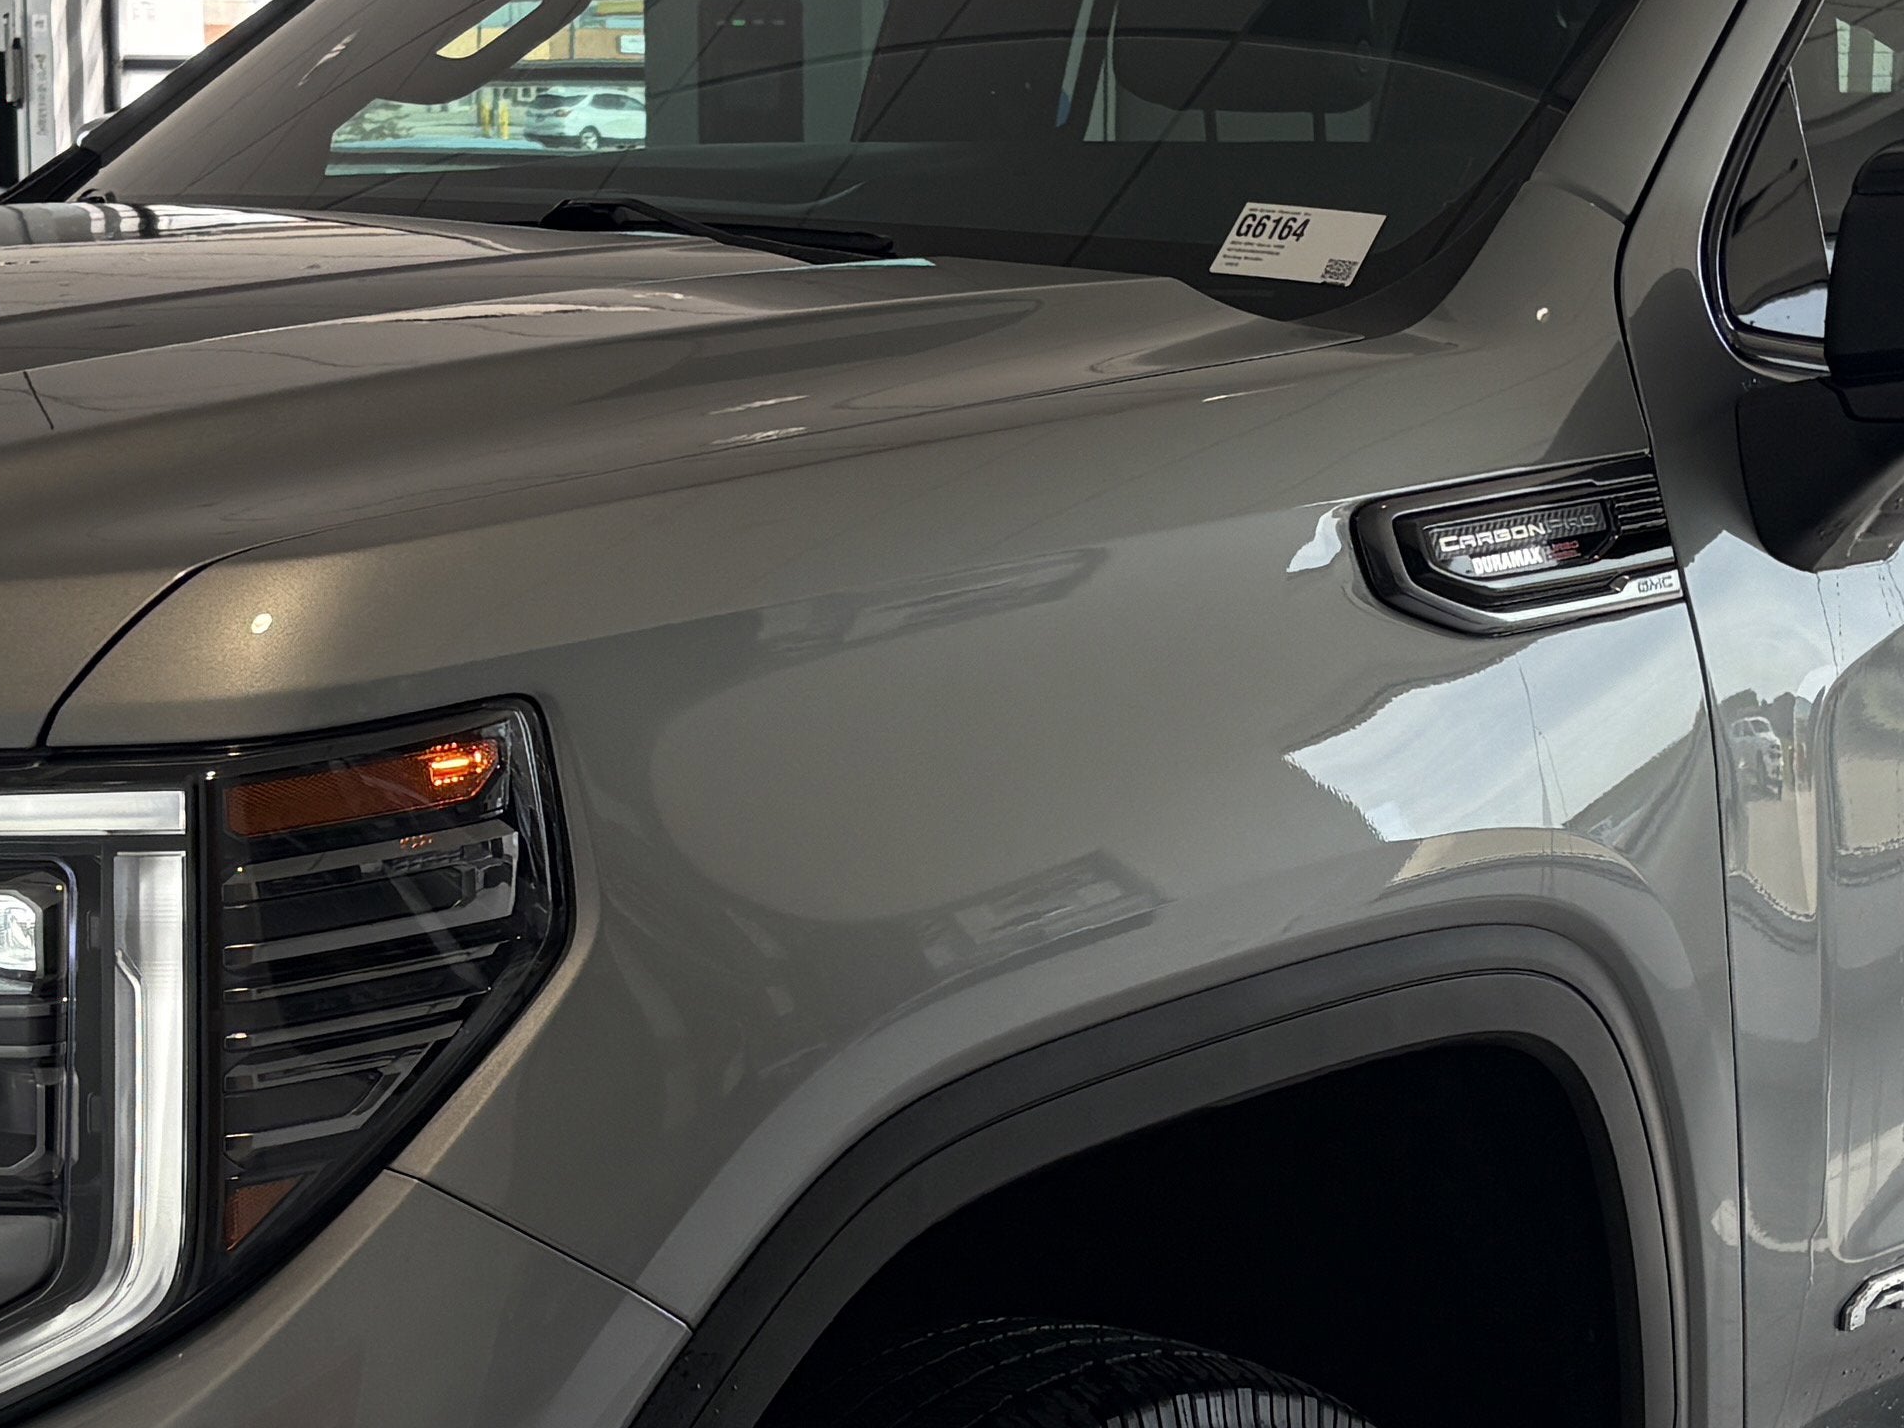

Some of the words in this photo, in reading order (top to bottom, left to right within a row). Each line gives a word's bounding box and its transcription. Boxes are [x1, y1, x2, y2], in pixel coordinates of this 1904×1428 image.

[1235, 213, 1310, 242] G6164
[1471, 545, 1543, 575] DURAMAX
[1637, 575, 1675, 594] GMC
